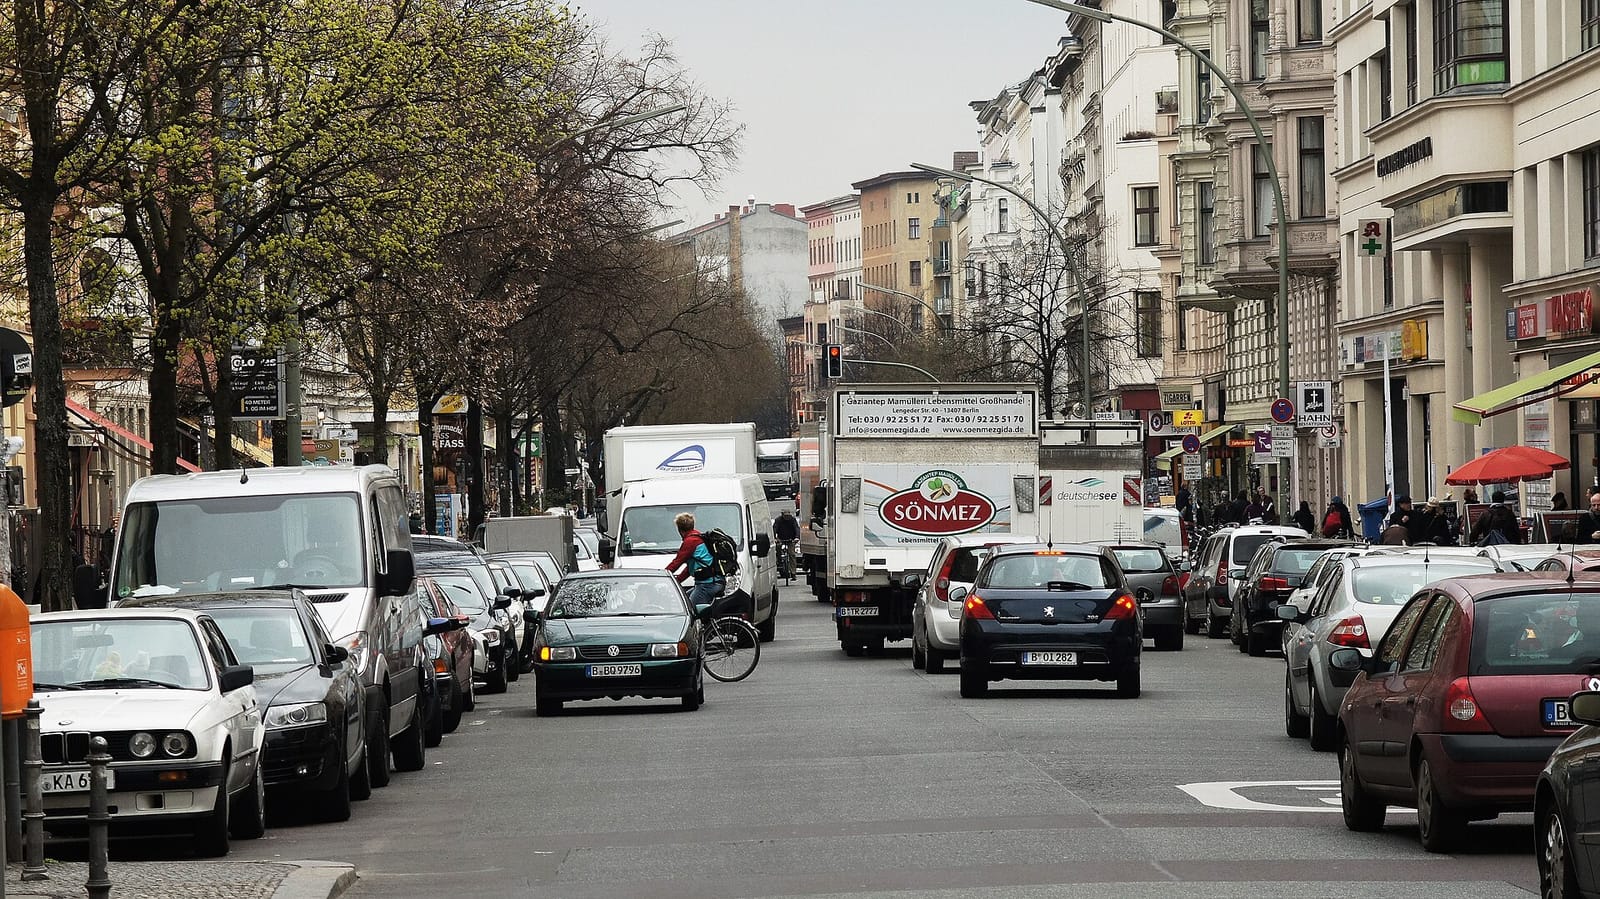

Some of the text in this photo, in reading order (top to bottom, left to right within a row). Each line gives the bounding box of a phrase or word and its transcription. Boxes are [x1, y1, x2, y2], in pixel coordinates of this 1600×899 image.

[846, 396, 1025, 406] Gaziantep Mamülleri Lebensmittel Großhandel
[892, 407, 919, 415] Lengeder
[848, 415, 863, 424] Tel:
[863, 415, 880, 424] 030
[886, 415, 897, 424] 92
[898, 415, 909, 424] 25
[910, 415, 920, 424] 51
[922, 415, 933, 424] 72
[936, 415, 953, 423] Fax:
[954, 415, 971, 423] 030
[976, 415, 988, 423] 92
[989, 415, 1000, 423] 25
[1001, 415, 1011, 423] 51
[1013, 415, 1024, 423] 70
[1299, 414, 1331, 422] HAHN
[848, 426, 1025, 435] info@soenmezgida.de www.soenmezgida.de
[440, 440, 464, 448] FASS
[1057, 491, 1118, 501] deutschesee
[894, 501, 981, 521] SÖNMEZ
[592, 666, 598, 676] B
[1556, 704, 1566, 720] B
